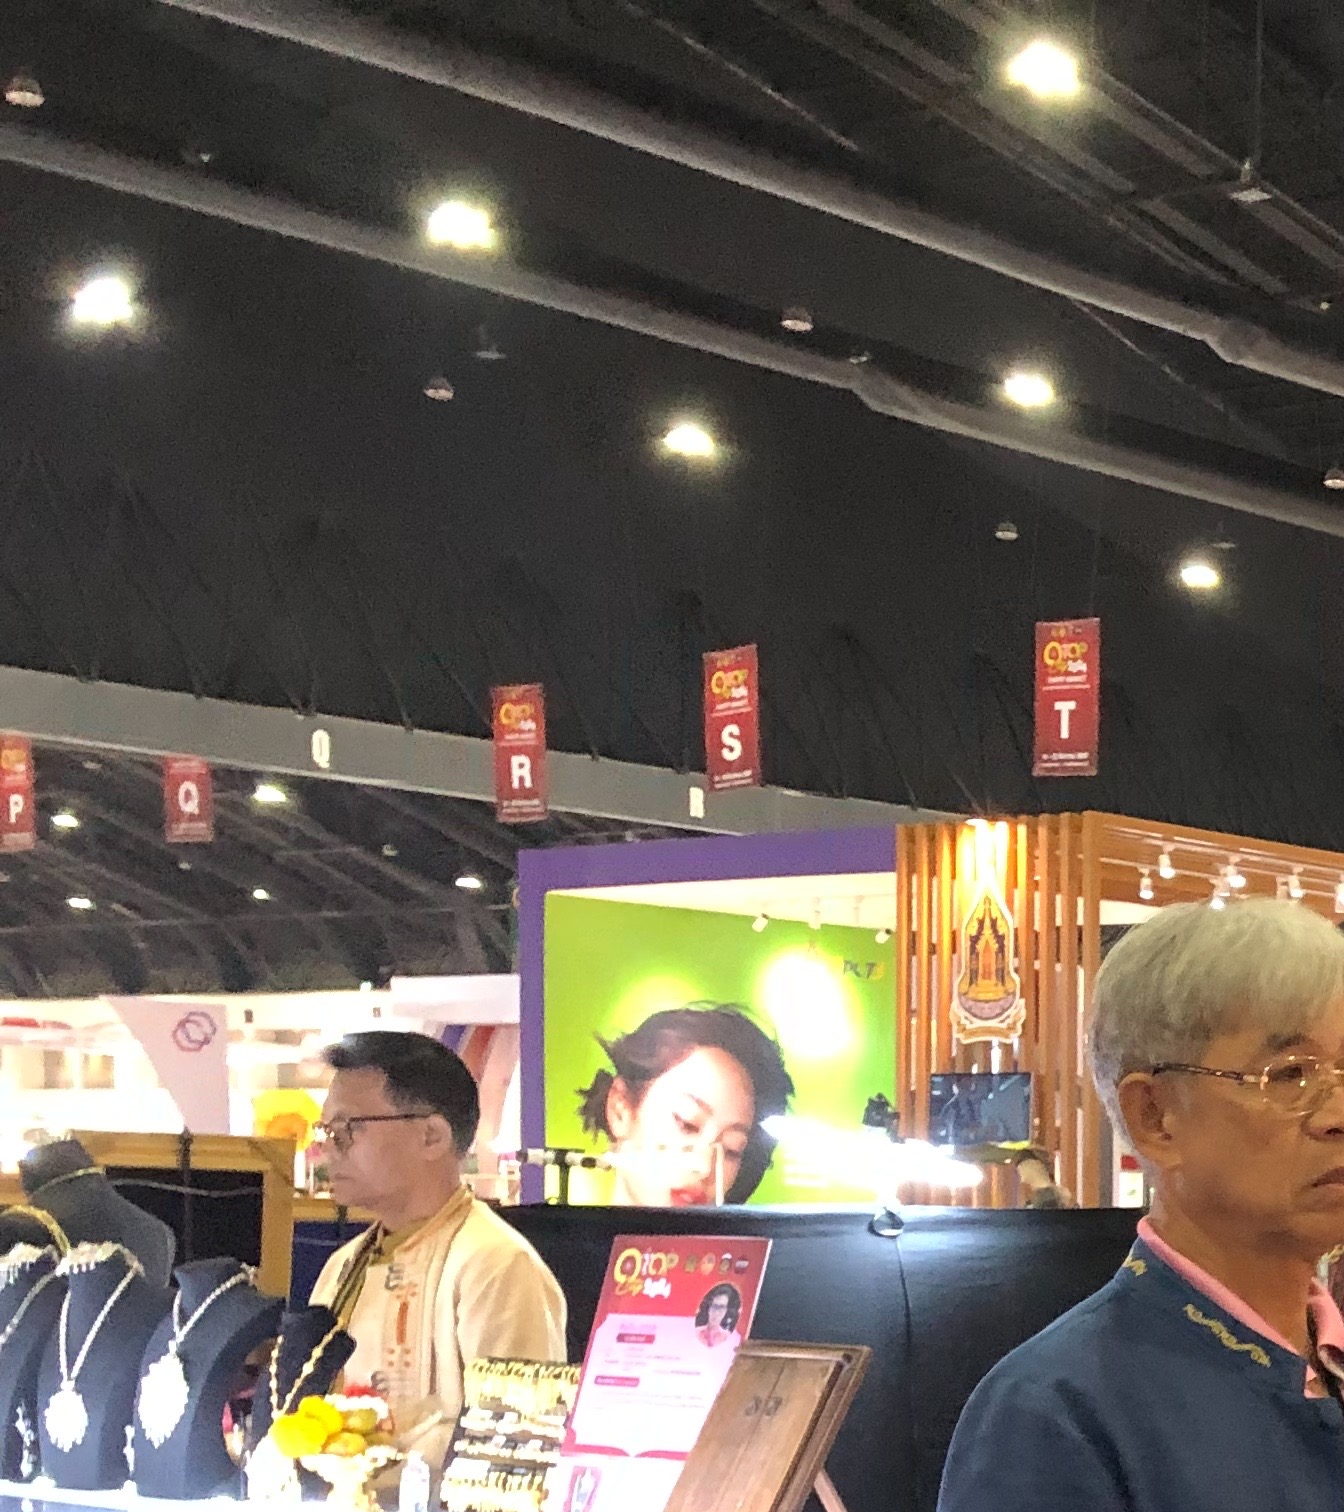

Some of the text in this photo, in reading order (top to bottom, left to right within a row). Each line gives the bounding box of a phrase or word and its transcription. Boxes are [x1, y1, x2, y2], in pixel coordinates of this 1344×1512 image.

[1054, 701, 1077, 739] T
[721, 724, 742, 761] S
[510, 754, 533, 789] R
[9, 794, 24, 823] P
[178, 780, 199, 814] Q
